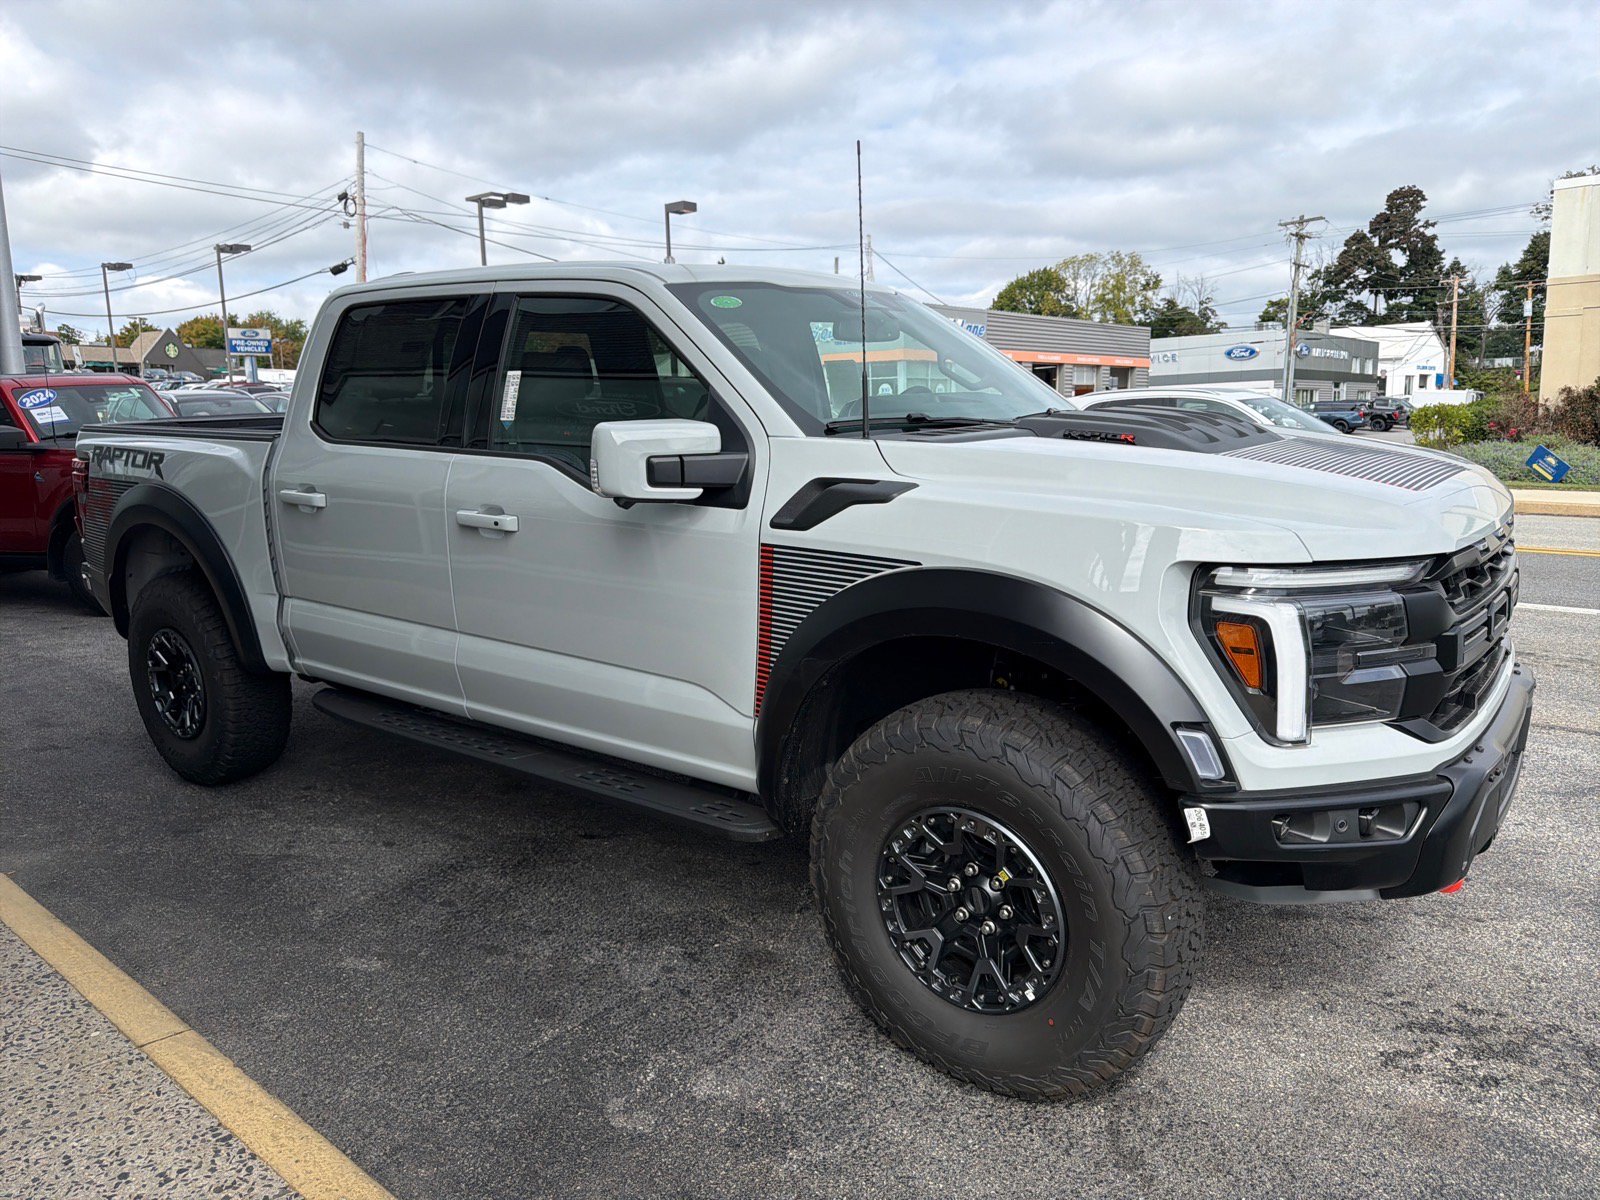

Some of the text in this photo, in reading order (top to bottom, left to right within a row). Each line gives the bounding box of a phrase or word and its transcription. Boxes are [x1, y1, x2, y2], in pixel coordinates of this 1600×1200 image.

[232, 339, 269, 347] PRE-OWNED
[1230, 348, 1251, 358] Ford
[22, 389, 54, 407] 2024
[90, 445, 166, 480] RAPTOR
